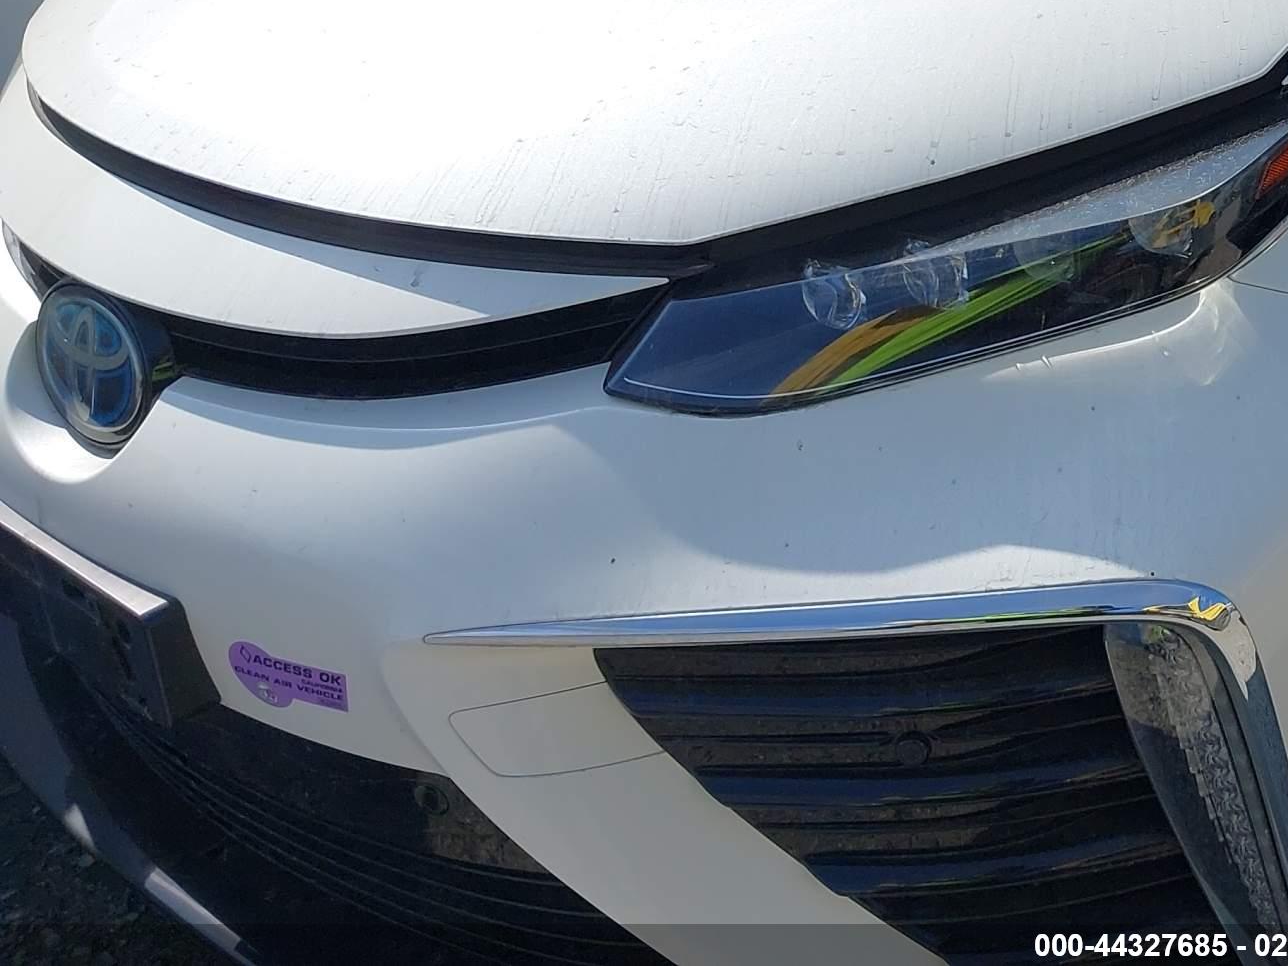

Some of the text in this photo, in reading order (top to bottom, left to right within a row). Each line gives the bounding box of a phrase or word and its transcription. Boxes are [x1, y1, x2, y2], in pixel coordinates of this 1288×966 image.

[234, 665, 343, 700] CLEAN AIR VEHICLE
[253, 655, 341, 686] ACCESS OK
